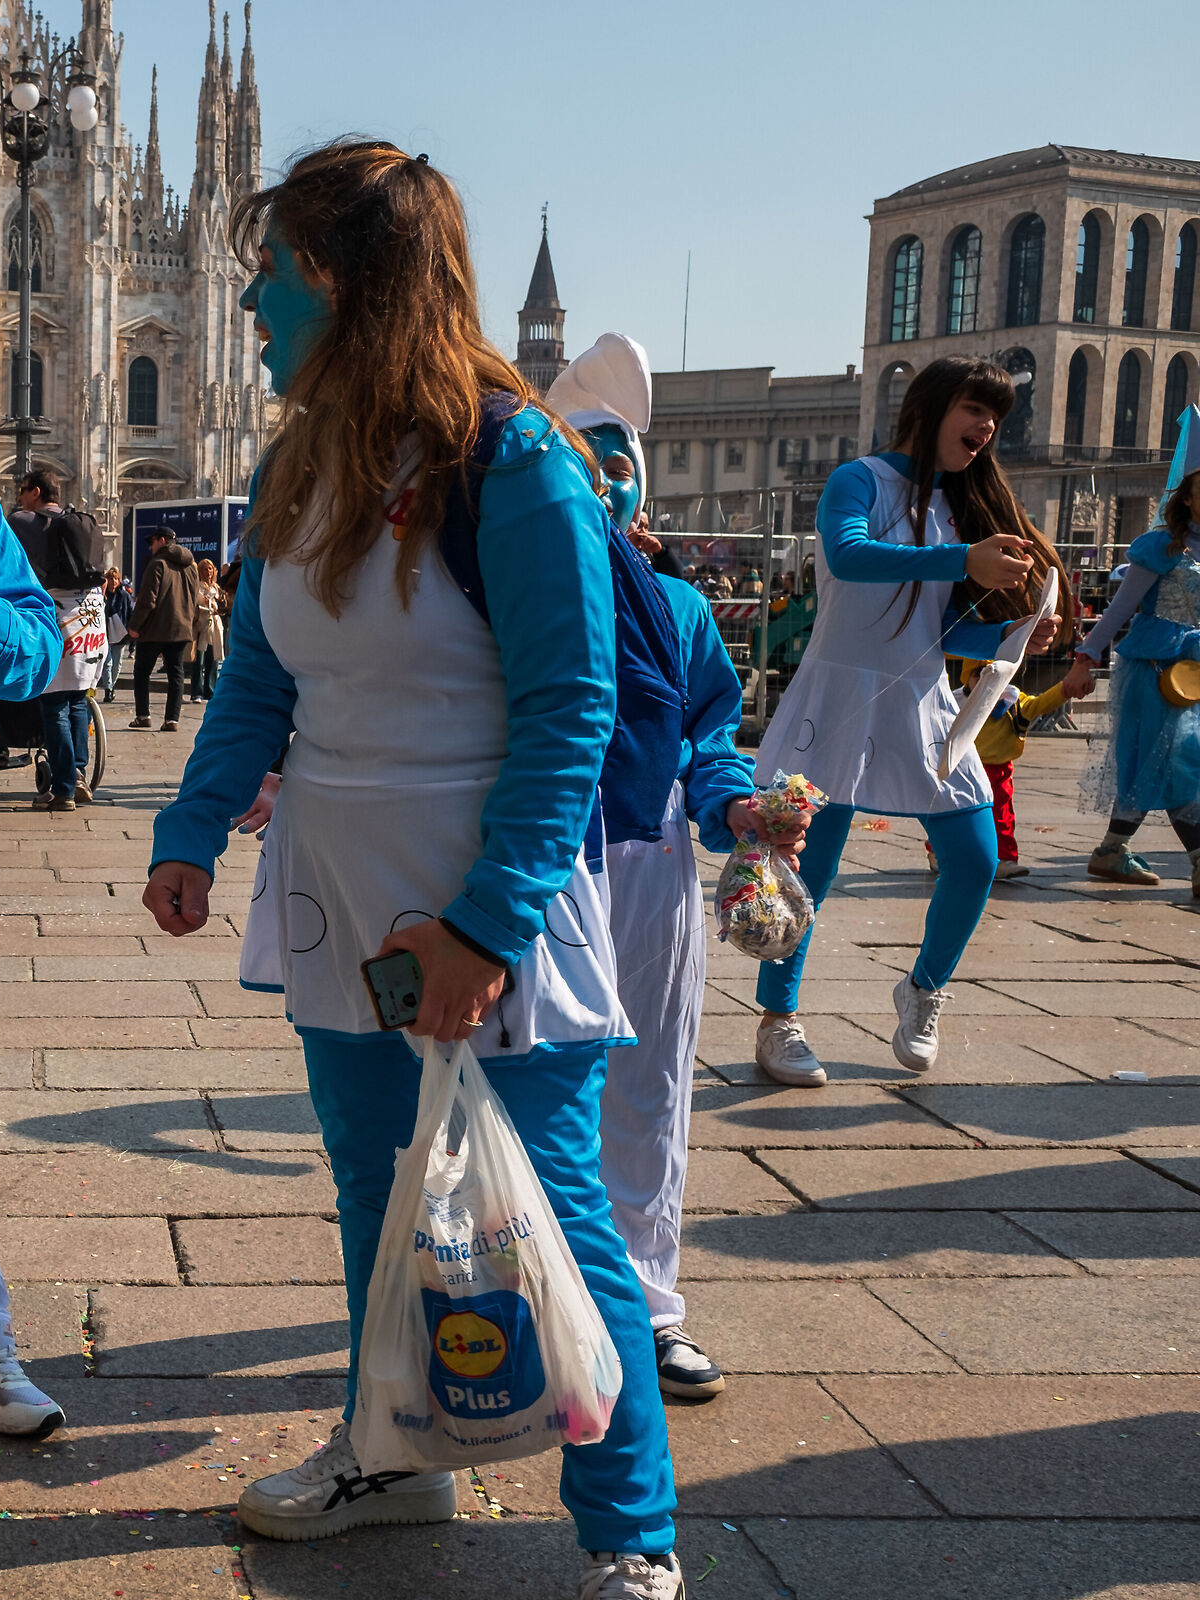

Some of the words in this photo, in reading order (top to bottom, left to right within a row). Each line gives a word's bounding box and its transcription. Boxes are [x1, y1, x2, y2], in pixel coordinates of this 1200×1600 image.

[193, 541, 218, 552] VILLAGE
[472, 1231, 491, 1257] di
[445, 1385, 511, 1411] Plus
